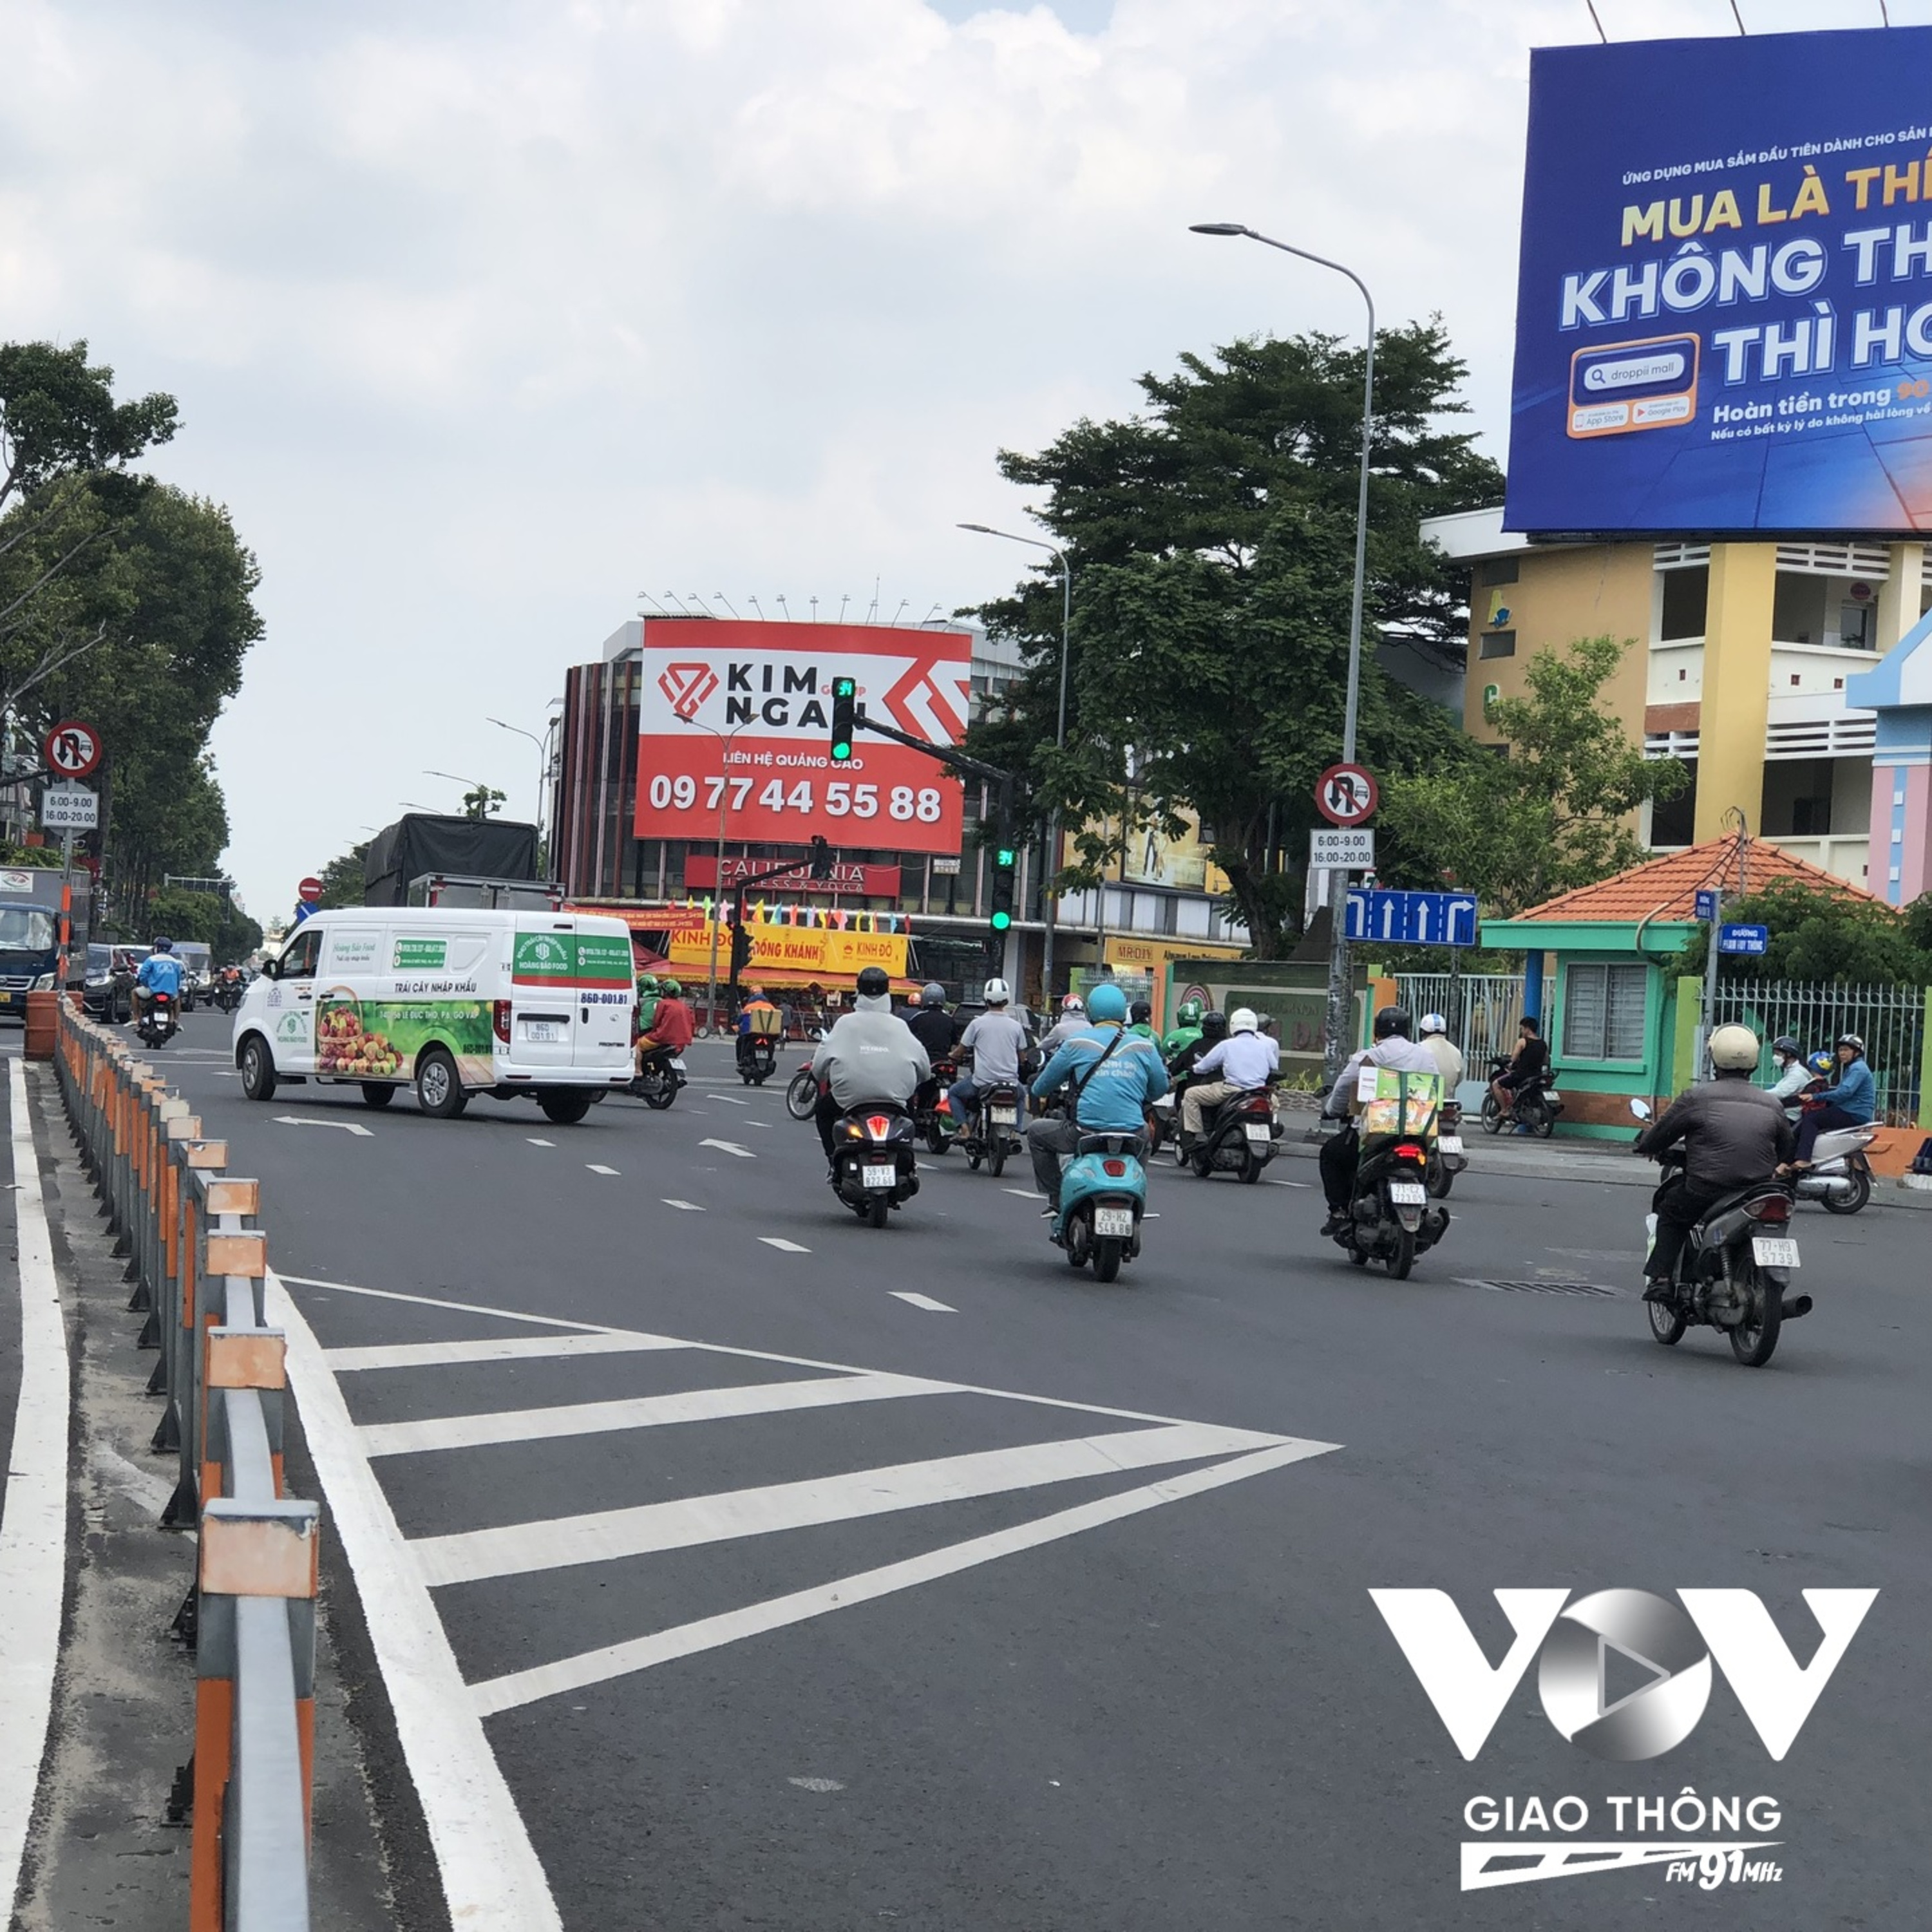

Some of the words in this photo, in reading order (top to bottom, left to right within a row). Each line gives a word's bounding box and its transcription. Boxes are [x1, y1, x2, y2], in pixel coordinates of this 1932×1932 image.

[1622, 171, 1652, 185] ỨNG
[1653, 164, 1692, 181] DỤNG
[1694, 158, 1724, 173] MUA
[1727, 150, 1756, 167] SẮM
[1790, 142, 1821, 158] TIÊN
[1824, 138, 1862, 153] DÀNH
[1864, 133, 1895, 147] CHO
[1897, 126, 1926, 142] SẢN
[1622, 189, 1742, 247] MUA
[1756, 164, 1830, 225] LÀ
[1561, 238, 1825, 329] KHÔNG
[1712, 300, 1835, 386] THÌ
[1611, 365, 1649, 381] droppii
[1651, 362, 1674, 375] mall
[1713, 401, 1773, 423] Hoàn
[1778, 392, 1822, 415] tiền
[1828, 388, 1891, 408] trong
[1897, 379, 1930, 401] 90
[1586, 418, 1602, 426] App
[1604, 414, 1624, 422] Store
[1711, 426, 1734, 440] Nếu
[1736, 424, 1751, 437] có
[1754, 422, 1775, 435] bất
[1808, 417, 1823, 428] do
[1825, 413, 1863, 426] không
[1866, 408, 1885, 421] hài
[1887, 406, 1913, 421] lòng
[727, 663, 817, 695] KIM
[723, 749, 752, 764] LIÊN
[753, 751, 773, 767] HỆ
[776, 752, 828, 768] QUẢNG
[649, 775, 696, 810] 09
[704, 777, 753, 811] 77
[759, 779, 813, 813] 44
[825, 783, 878, 817] 55
[889, 786, 942, 823] 88
[672, 929, 710, 946] KINH
[857, 942, 877, 956] KINH
[879, 940, 893, 958] ĐÔ
[394, 980, 411, 992] TRÁI
[412, 981, 428, 992] CÂY
[431, 982, 453, 994] NHẬP
[455, 978, 477, 992] KHẨU
[1762, 1252, 1793, 1265] 5739
